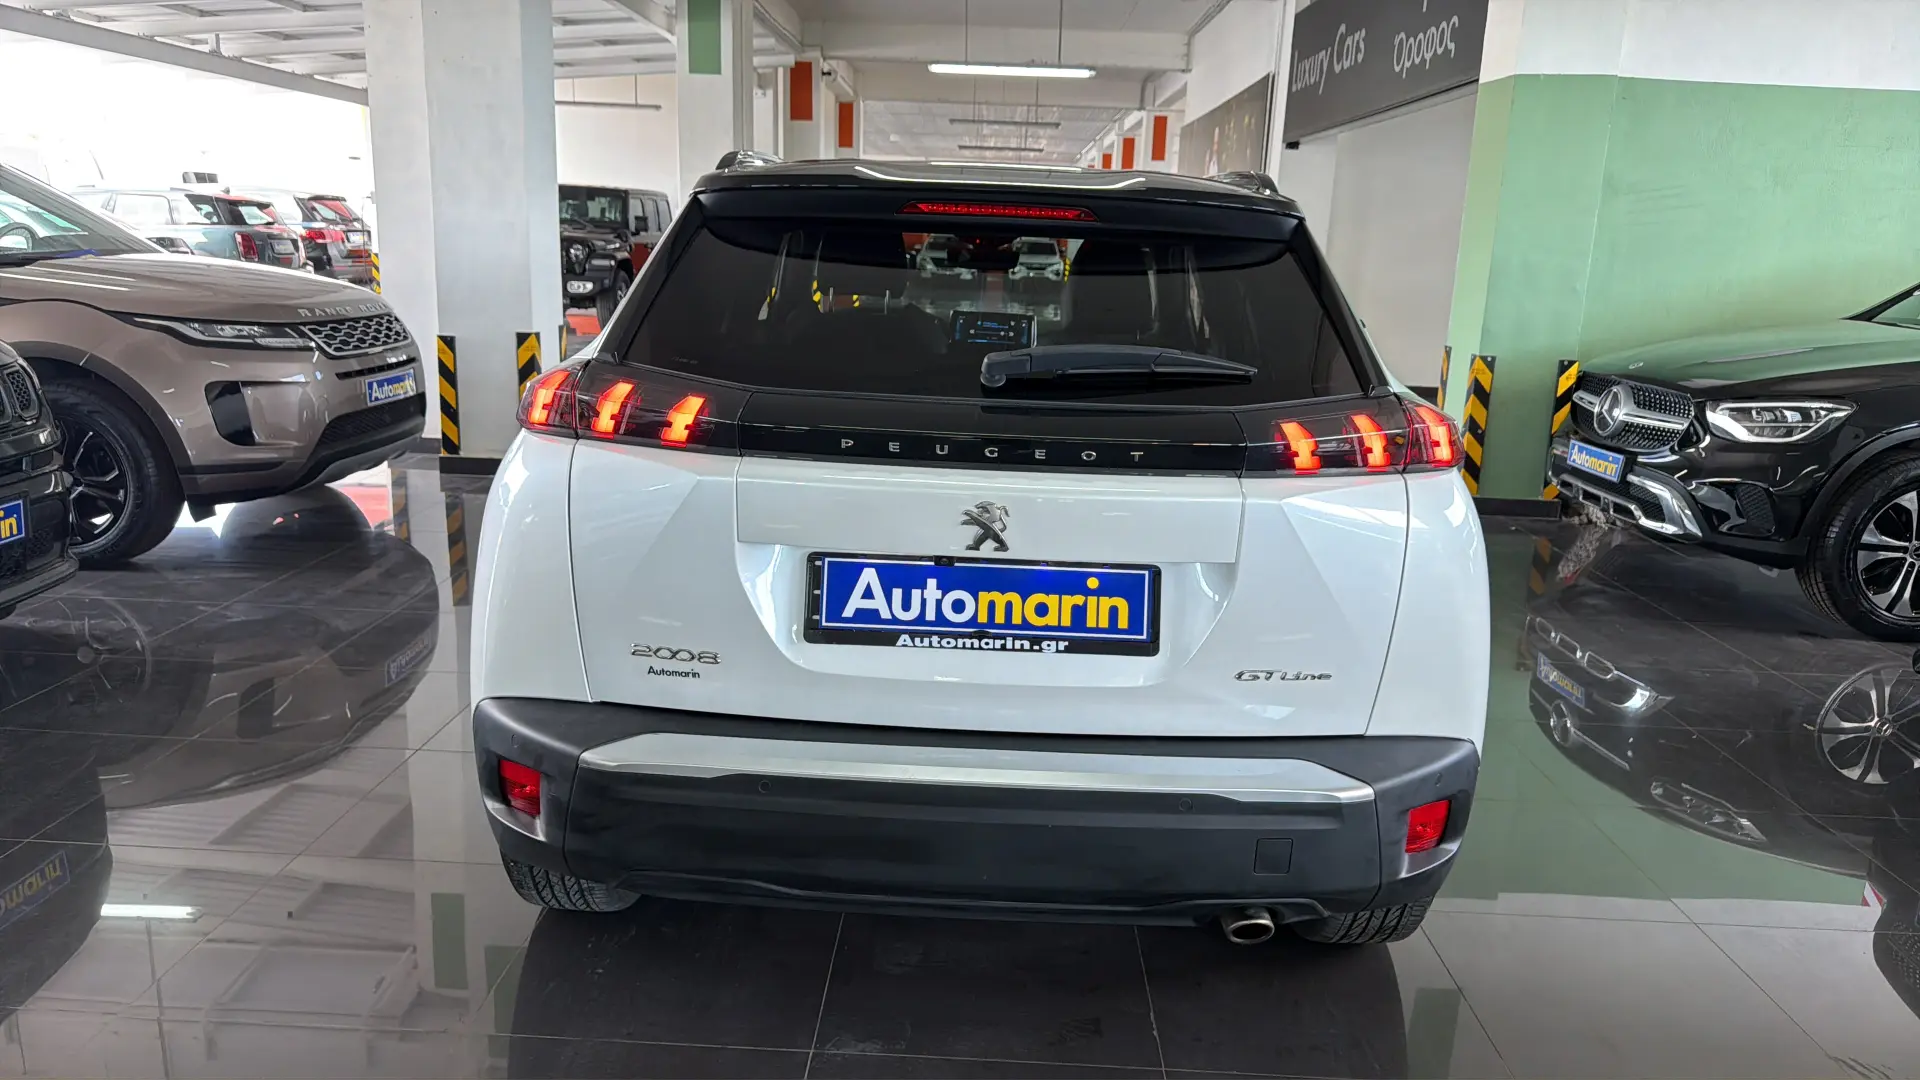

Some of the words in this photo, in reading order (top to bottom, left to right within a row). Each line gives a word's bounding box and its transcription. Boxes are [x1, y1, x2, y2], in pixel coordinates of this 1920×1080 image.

[1291, 47, 1332, 95] Luxury
[1333, 23, 1366, 74] Cars
[840, 438, 1144, 462] PEUGEOT
[1570, 444, 1617, 477] Automarin
[841, 567, 1130, 629] Automarin
[630, 643, 722, 665] 2008
[895, 633, 1070, 653] Automarin.gr
[647, 665, 701, 679] Automarin
